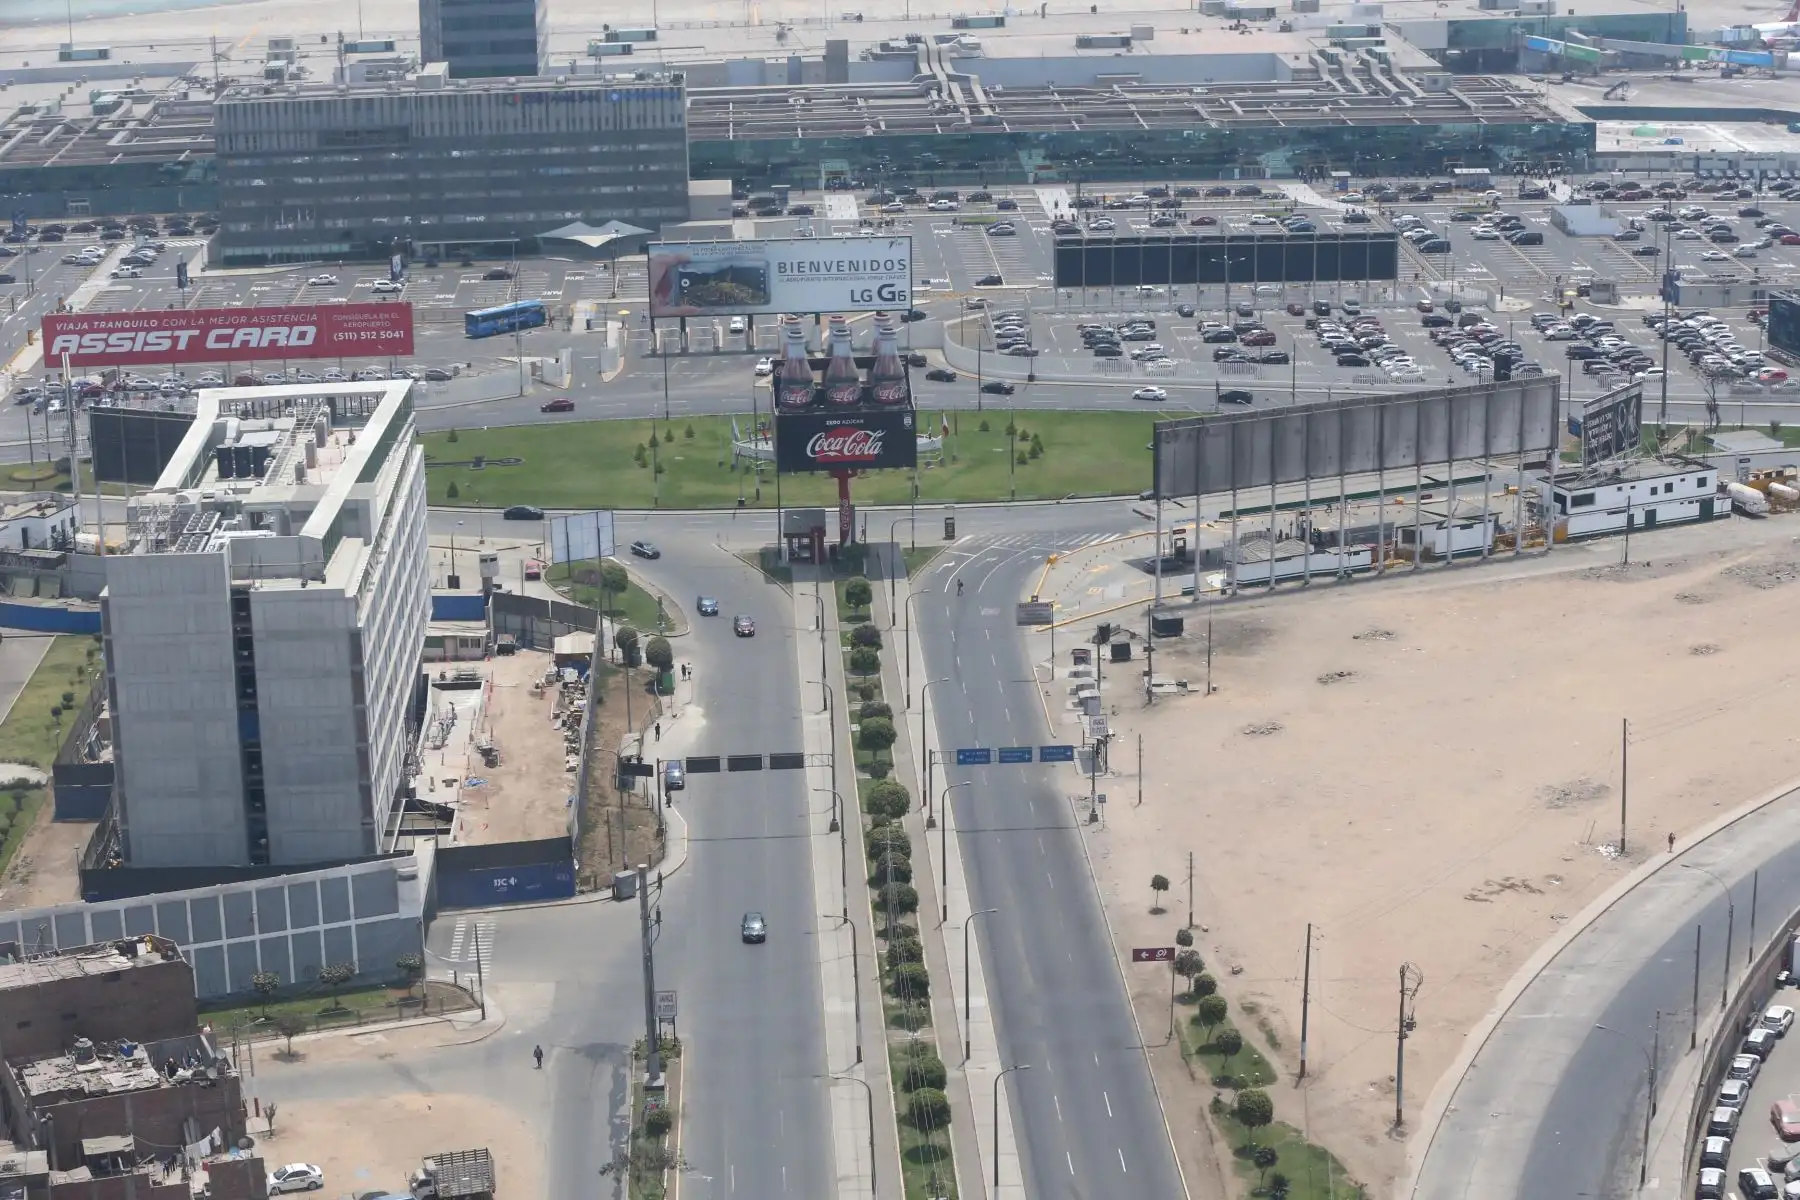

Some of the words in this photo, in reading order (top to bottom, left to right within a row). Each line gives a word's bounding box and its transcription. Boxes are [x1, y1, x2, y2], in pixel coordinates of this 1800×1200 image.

[777, 258, 907, 274] BIENVENIDOS
[850, 289, 873, 303] LG
[877, 283, 907, 302] G6
[56, 321, 89, 331] VIAJA
[93, 319, 158, 329] TRANQUILO
[162, 318, 187, 327] CON
[191, 317, 205, 326] LA
[209, 315, 247, 325] MEJOR
[252, 313, 318, 324] ASISTENCIA
[50, 329, 201, 355] ASSIST
[205, 325, 317, 350] CARD
[333, 331, 357, 342] (511)
[360, 330, 377, 340] 512
[380, 330, 404, 339] 5041
[806, 429, 887, 458] Coca-Cola
